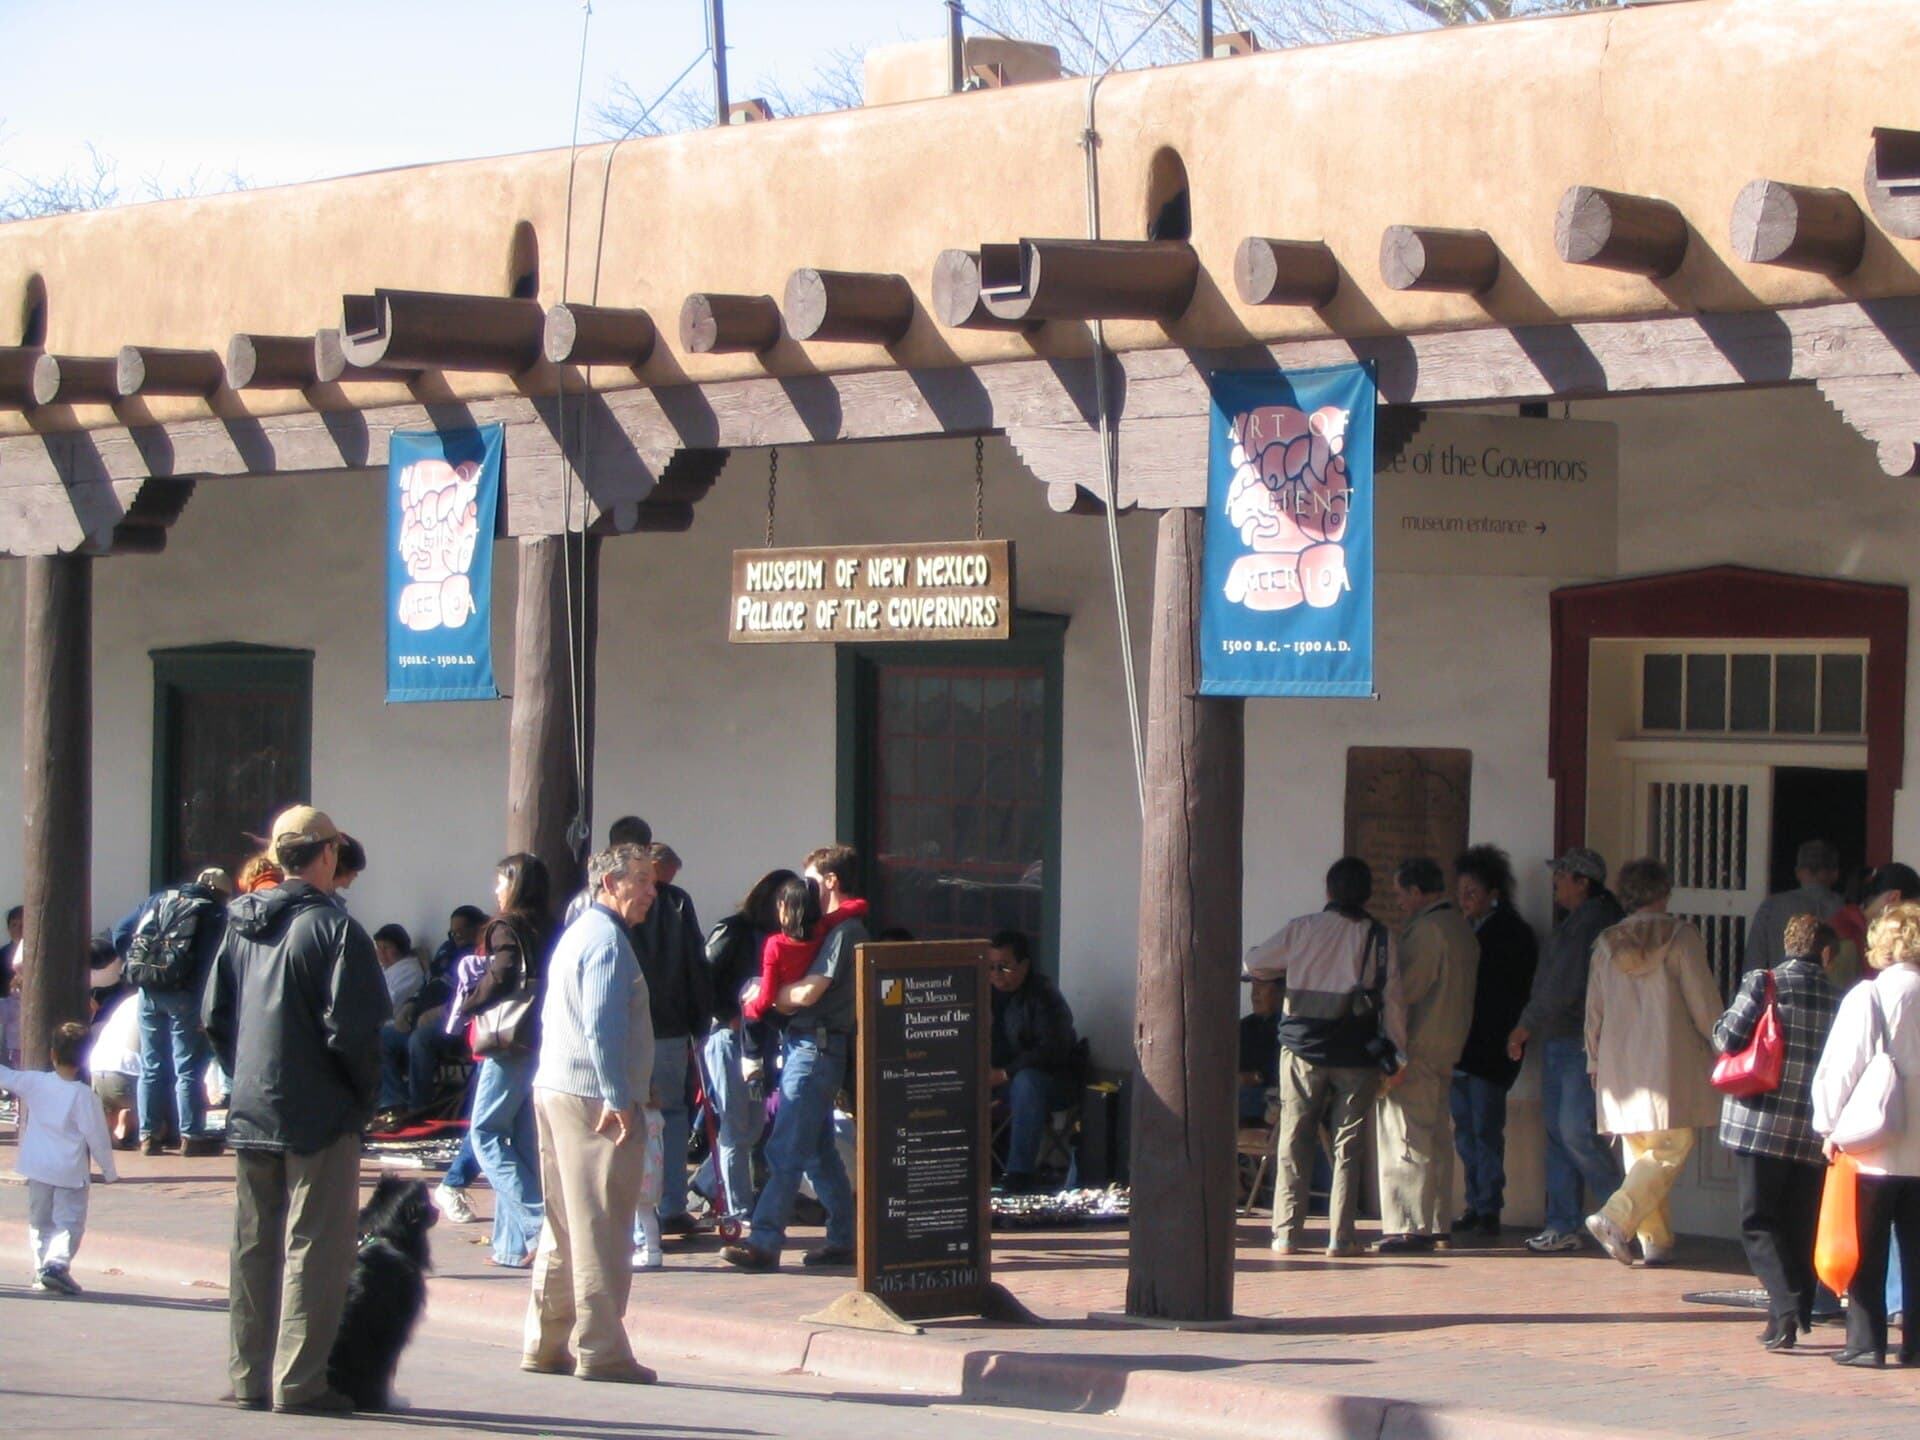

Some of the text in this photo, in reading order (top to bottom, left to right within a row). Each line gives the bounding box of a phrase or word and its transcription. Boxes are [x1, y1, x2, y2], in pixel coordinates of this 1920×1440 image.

[1228, 413, 1285, 440] ART
[1412, 443, 1435, 475] of
[1441, 444, 1476, 477] the
[1482, 446, 1588, 483] Governors
[1401, 514, 1528, 535] museum entrance
[835, 559, 858, 588] OF
[815, 599, 838, 630] OF
[1222, 639, 1251, 655] 1500
[1255, 640, 1281, 652] B.C.
[1293, 640, 1322, 656] 1500
[1324, 640, 1352, 652] A.D.
[905, 975, 953, 990] Museum of
[905, 991, 957, 1005] New Mexico
[905, 1010, 970, 1025] Palace of the
[905, 1027, 959, 1040] Governors
[888, 1196, 907, 1207] Free
[888, 1208, 907, 1218] Free
